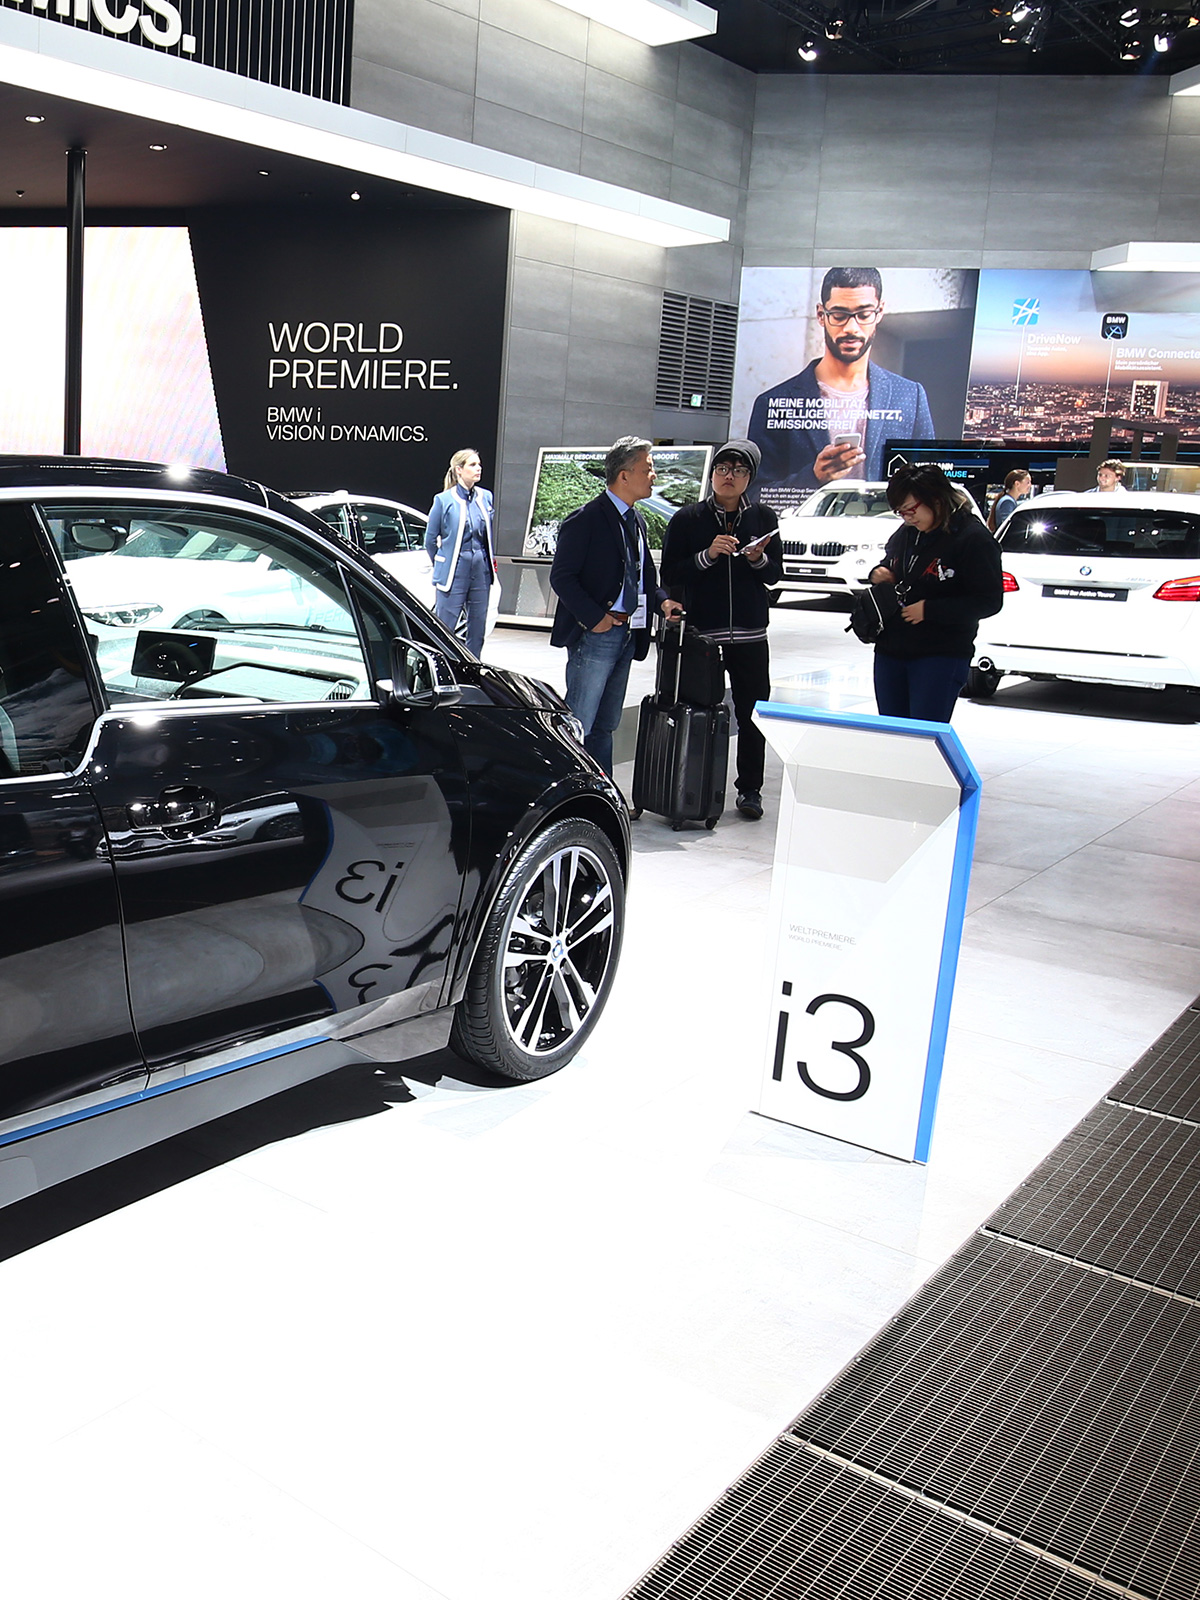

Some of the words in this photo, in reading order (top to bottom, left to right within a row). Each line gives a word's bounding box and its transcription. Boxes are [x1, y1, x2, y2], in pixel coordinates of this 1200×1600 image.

[1106, 316, 1126, 324] BMW
[268, 322, 404, 353] WORLD
[1027, 333, 1081, 345] DriveNow
[1116, 348, 1146, 358] BMW
[268, 359, 458, 390] PREMIERE.
[768, 398, 804, 409] MEINE
[267, 406, 314, 423] BMW
[316, 407, 322, 423] i
[768, 408, 841, 420] INTELLIGENT,
[843, 409, 903, 422] VERNETZT,
[266, 425, 325, 441] VISION
[330, 425, 430, 442] DYNAMICS.
[788, 934, 811, 944] WORLD
[811, 938, 843, 951] PREMIERE.
[789, 923, 857, 946] WELTPREMIERE.
[772, 980, 876, 1102] i3
